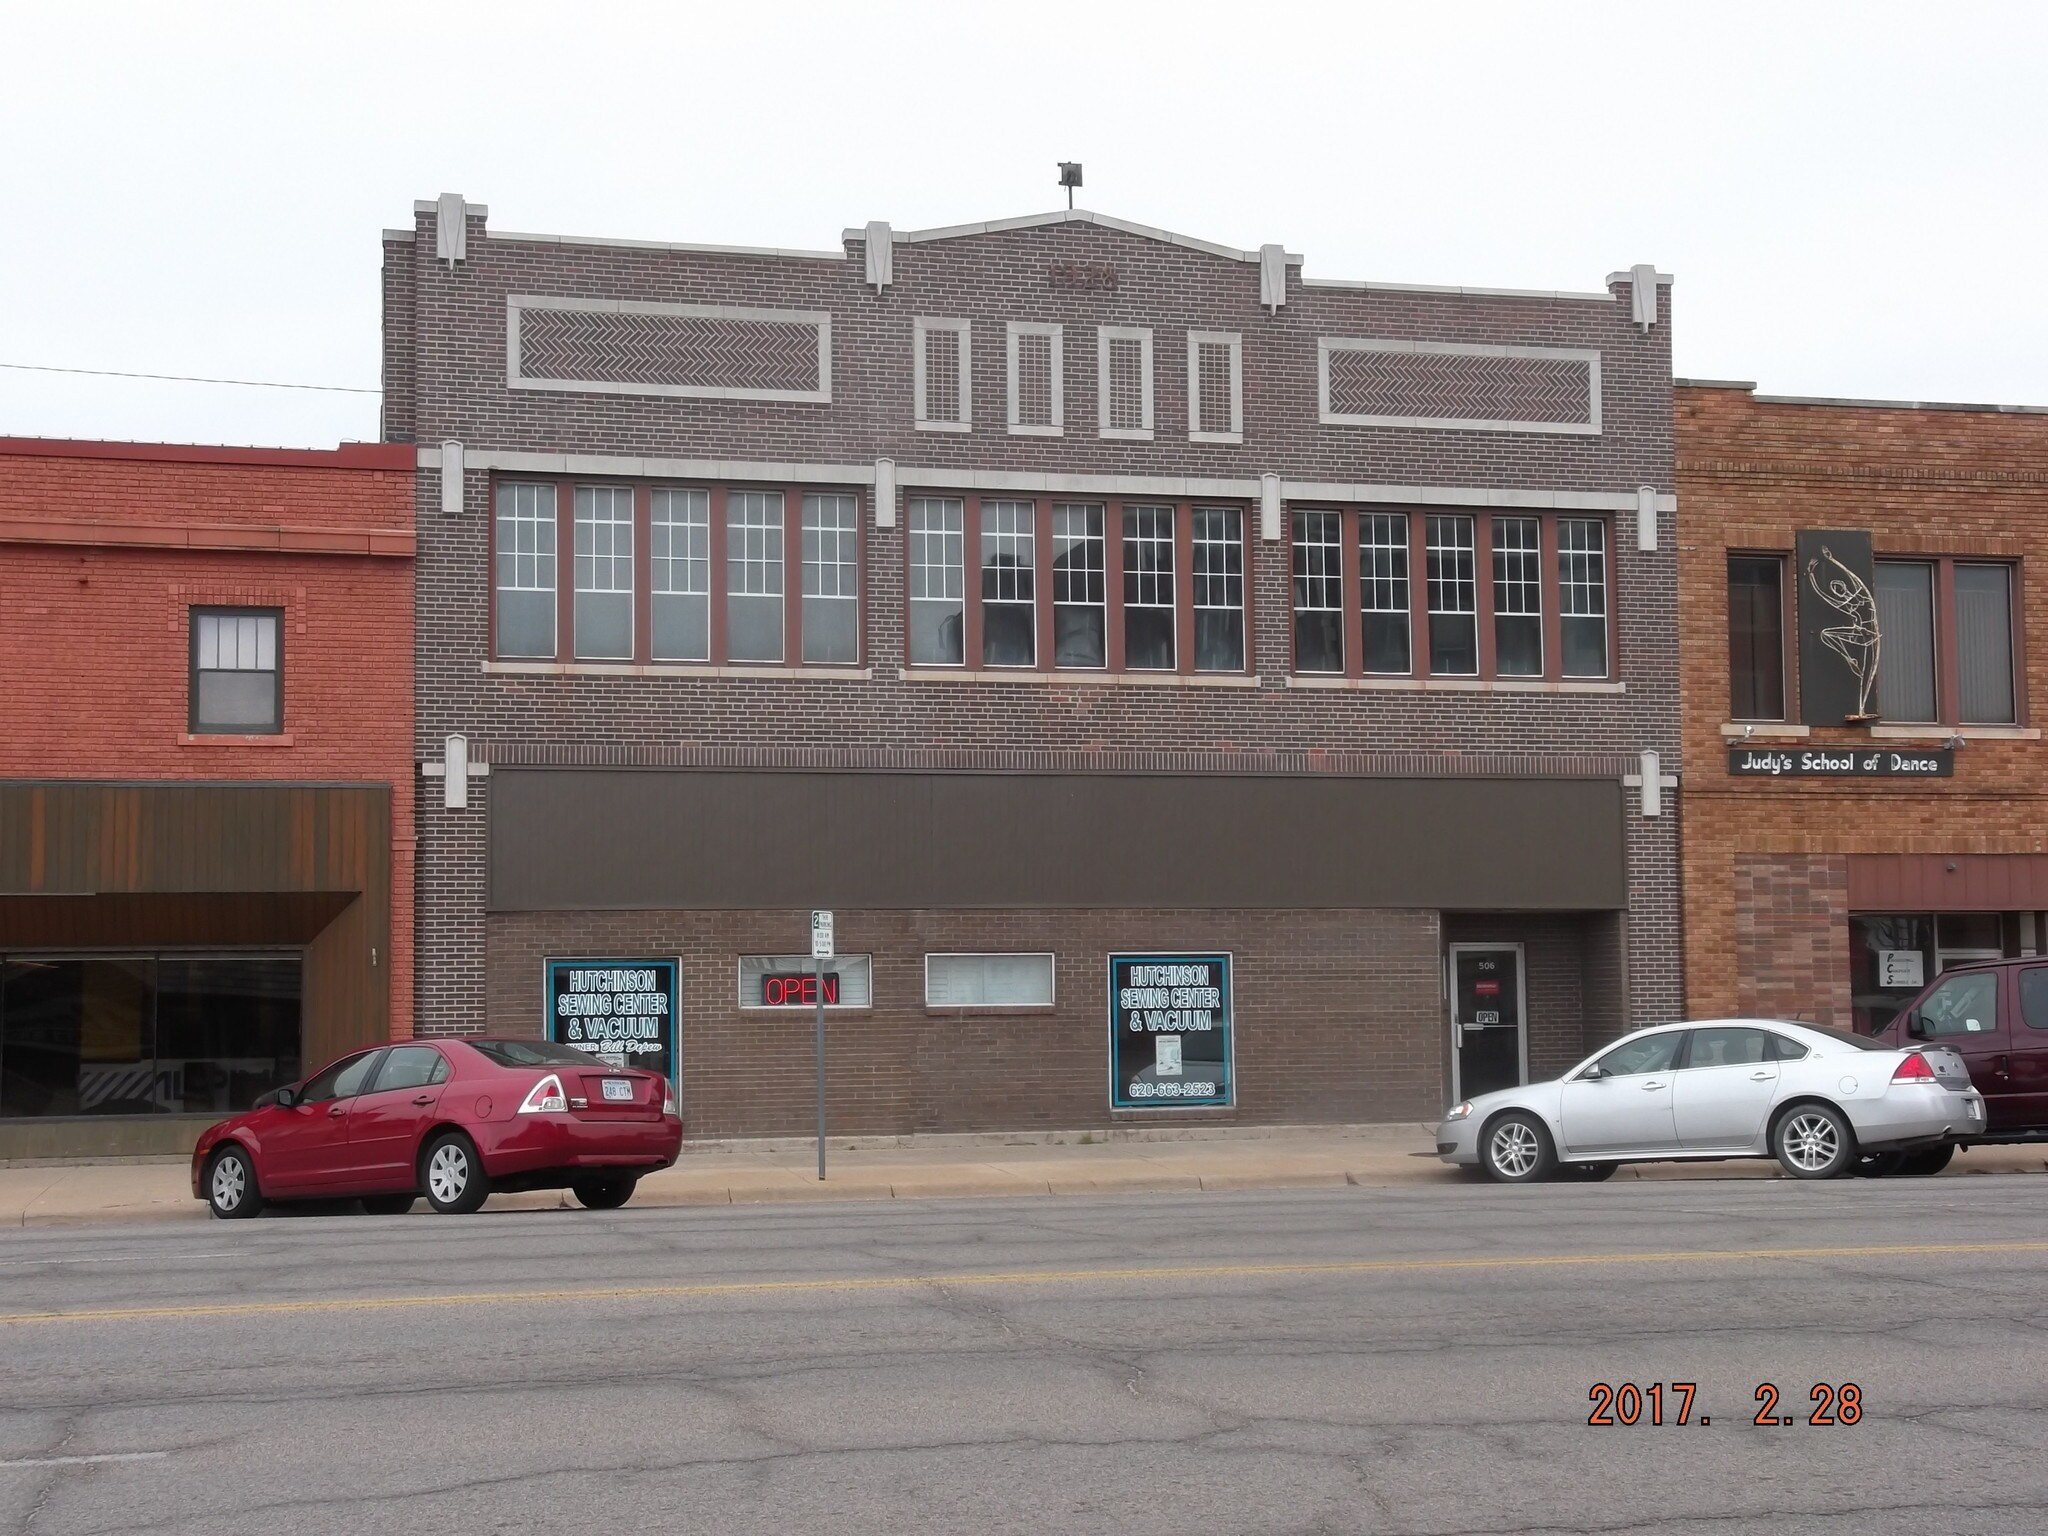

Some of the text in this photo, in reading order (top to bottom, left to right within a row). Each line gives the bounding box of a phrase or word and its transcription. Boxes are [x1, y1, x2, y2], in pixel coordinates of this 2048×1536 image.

[1741, 752, 1938, 775] Judy's School of Dance
[813, 914, 819, 927] 2
[1130, 965, 1209, 987] HUTCHINSON
[1478, 962, 1496, 970] 506
[569, 970, 656, 992] HUTCHINSON
[766, 978, 836, 1005] OPEN
[558, 993, 668, 1016] SEWING CENTER
[1120, 987, 1220, 1010] SEWING CENTER
[1129, 1010, 1212, 1032] & VACUUM
[1478, 1012, 1498, 1022] OPEN
[568, 1017, 659, 1040] & VACUUM
[600, 1040, 625, 1053] Bill
[1129, 1082, 1216, 1098] 620-663-2523
